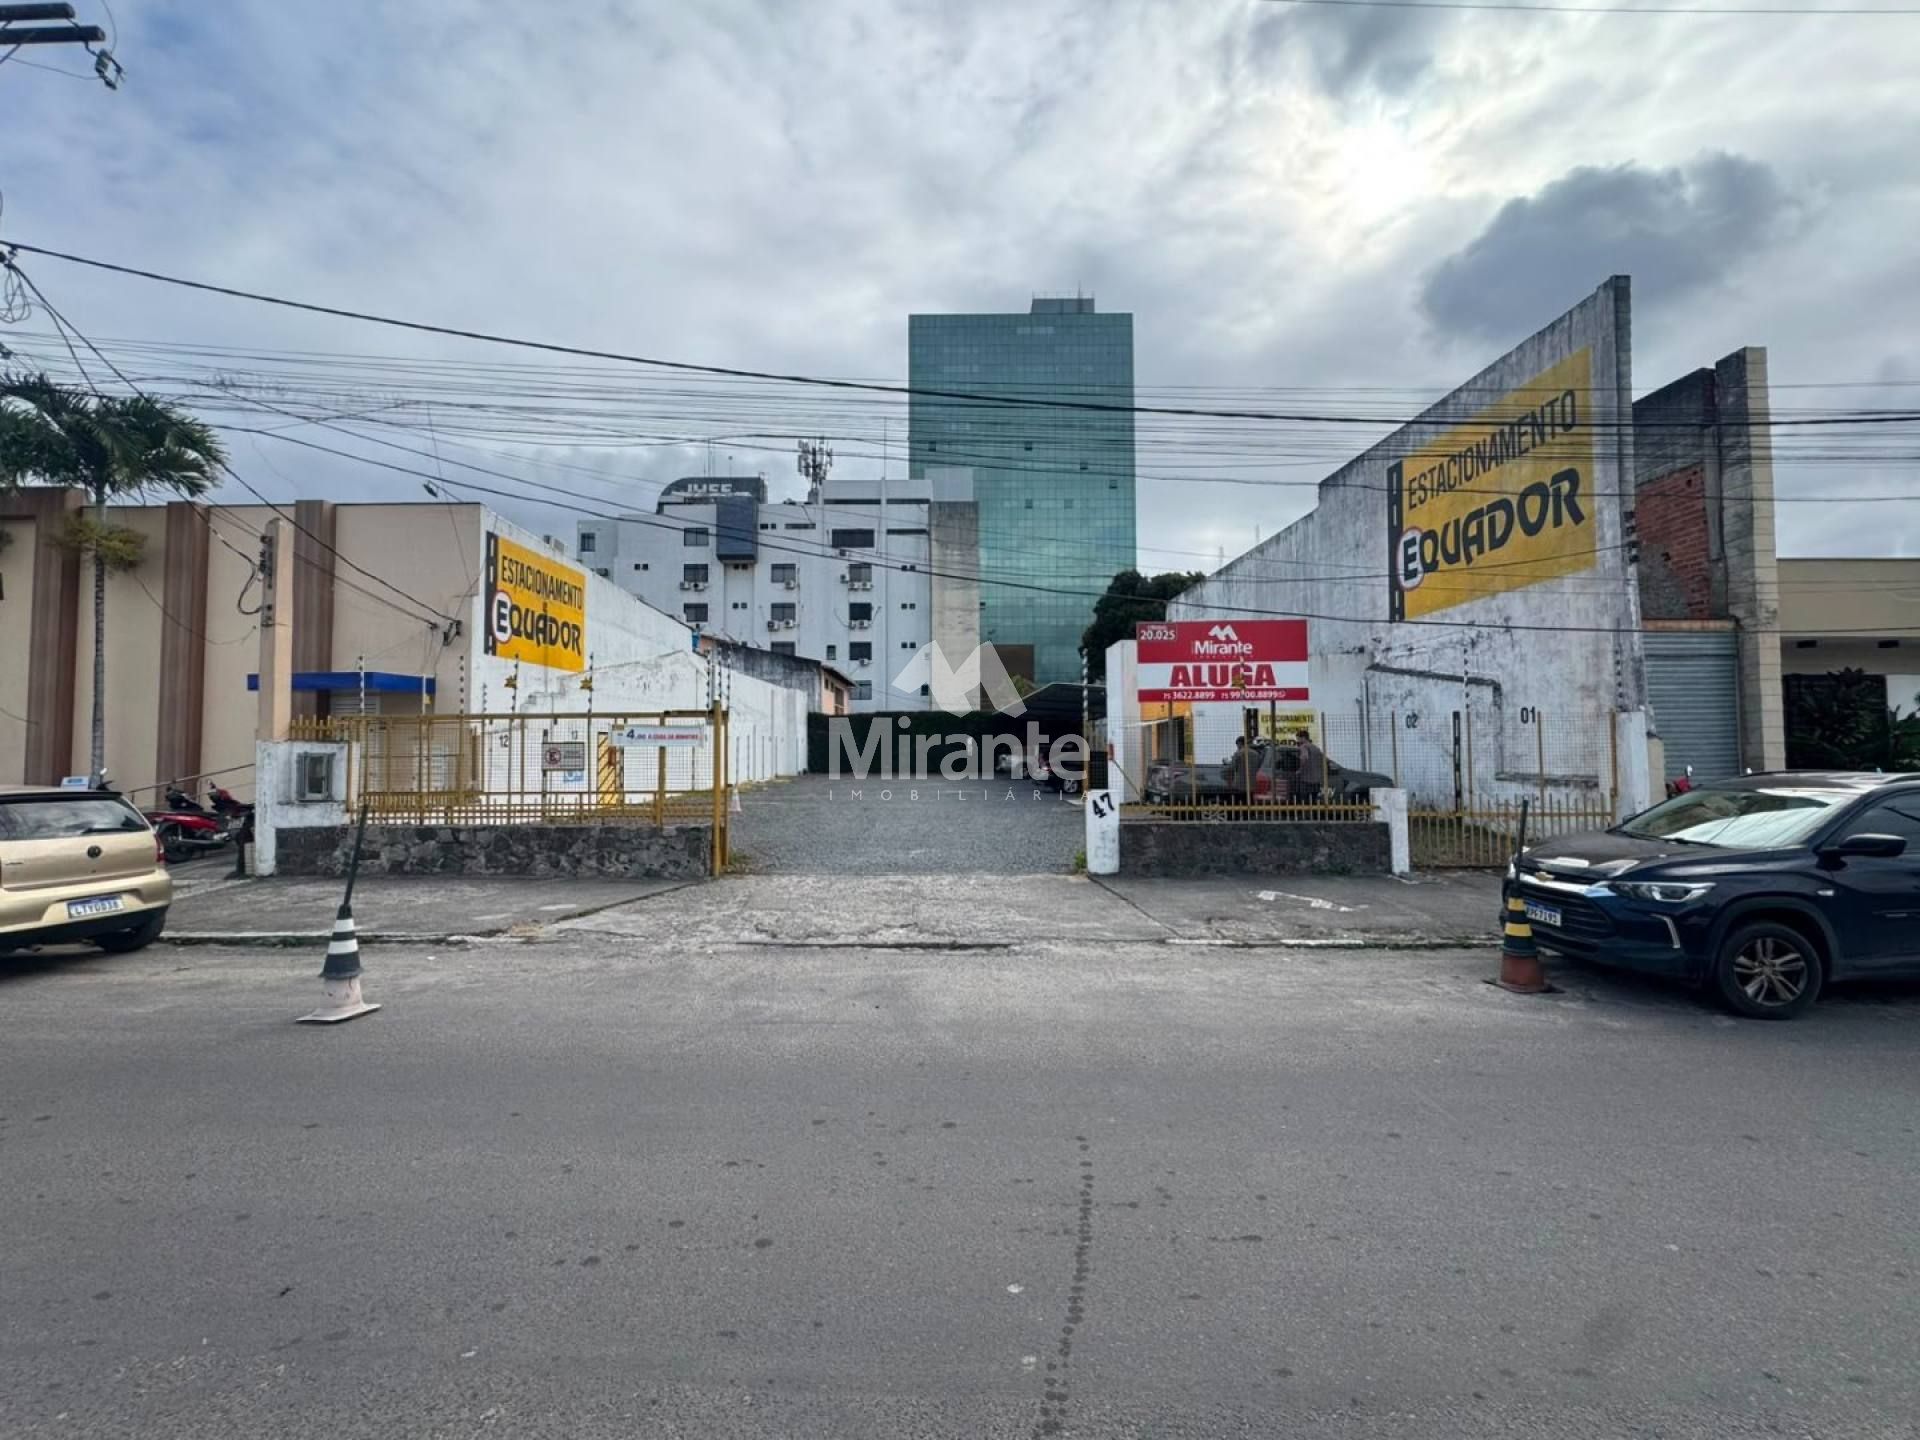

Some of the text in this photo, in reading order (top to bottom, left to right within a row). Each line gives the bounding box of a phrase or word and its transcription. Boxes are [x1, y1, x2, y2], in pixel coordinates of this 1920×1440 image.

[1407, 389, 1576, 510] ESTACIONAMENTO
[1403, 467, 1585, 581] EQUADOR
[501, 555, 583, 610] ESTACIONAMENTO
[496, 599, 582, 657] EQUADOR
[1140, 630, 1176, 640] 20.025
[1194, 640, 1253, 655] Mirante
[1169, 664, 1277, 687] ALUGA
[1405, 712, 1418, 728] 02
[1520, 706, 1536, 724] 01
[1092, 792, 1115, 819] 47
